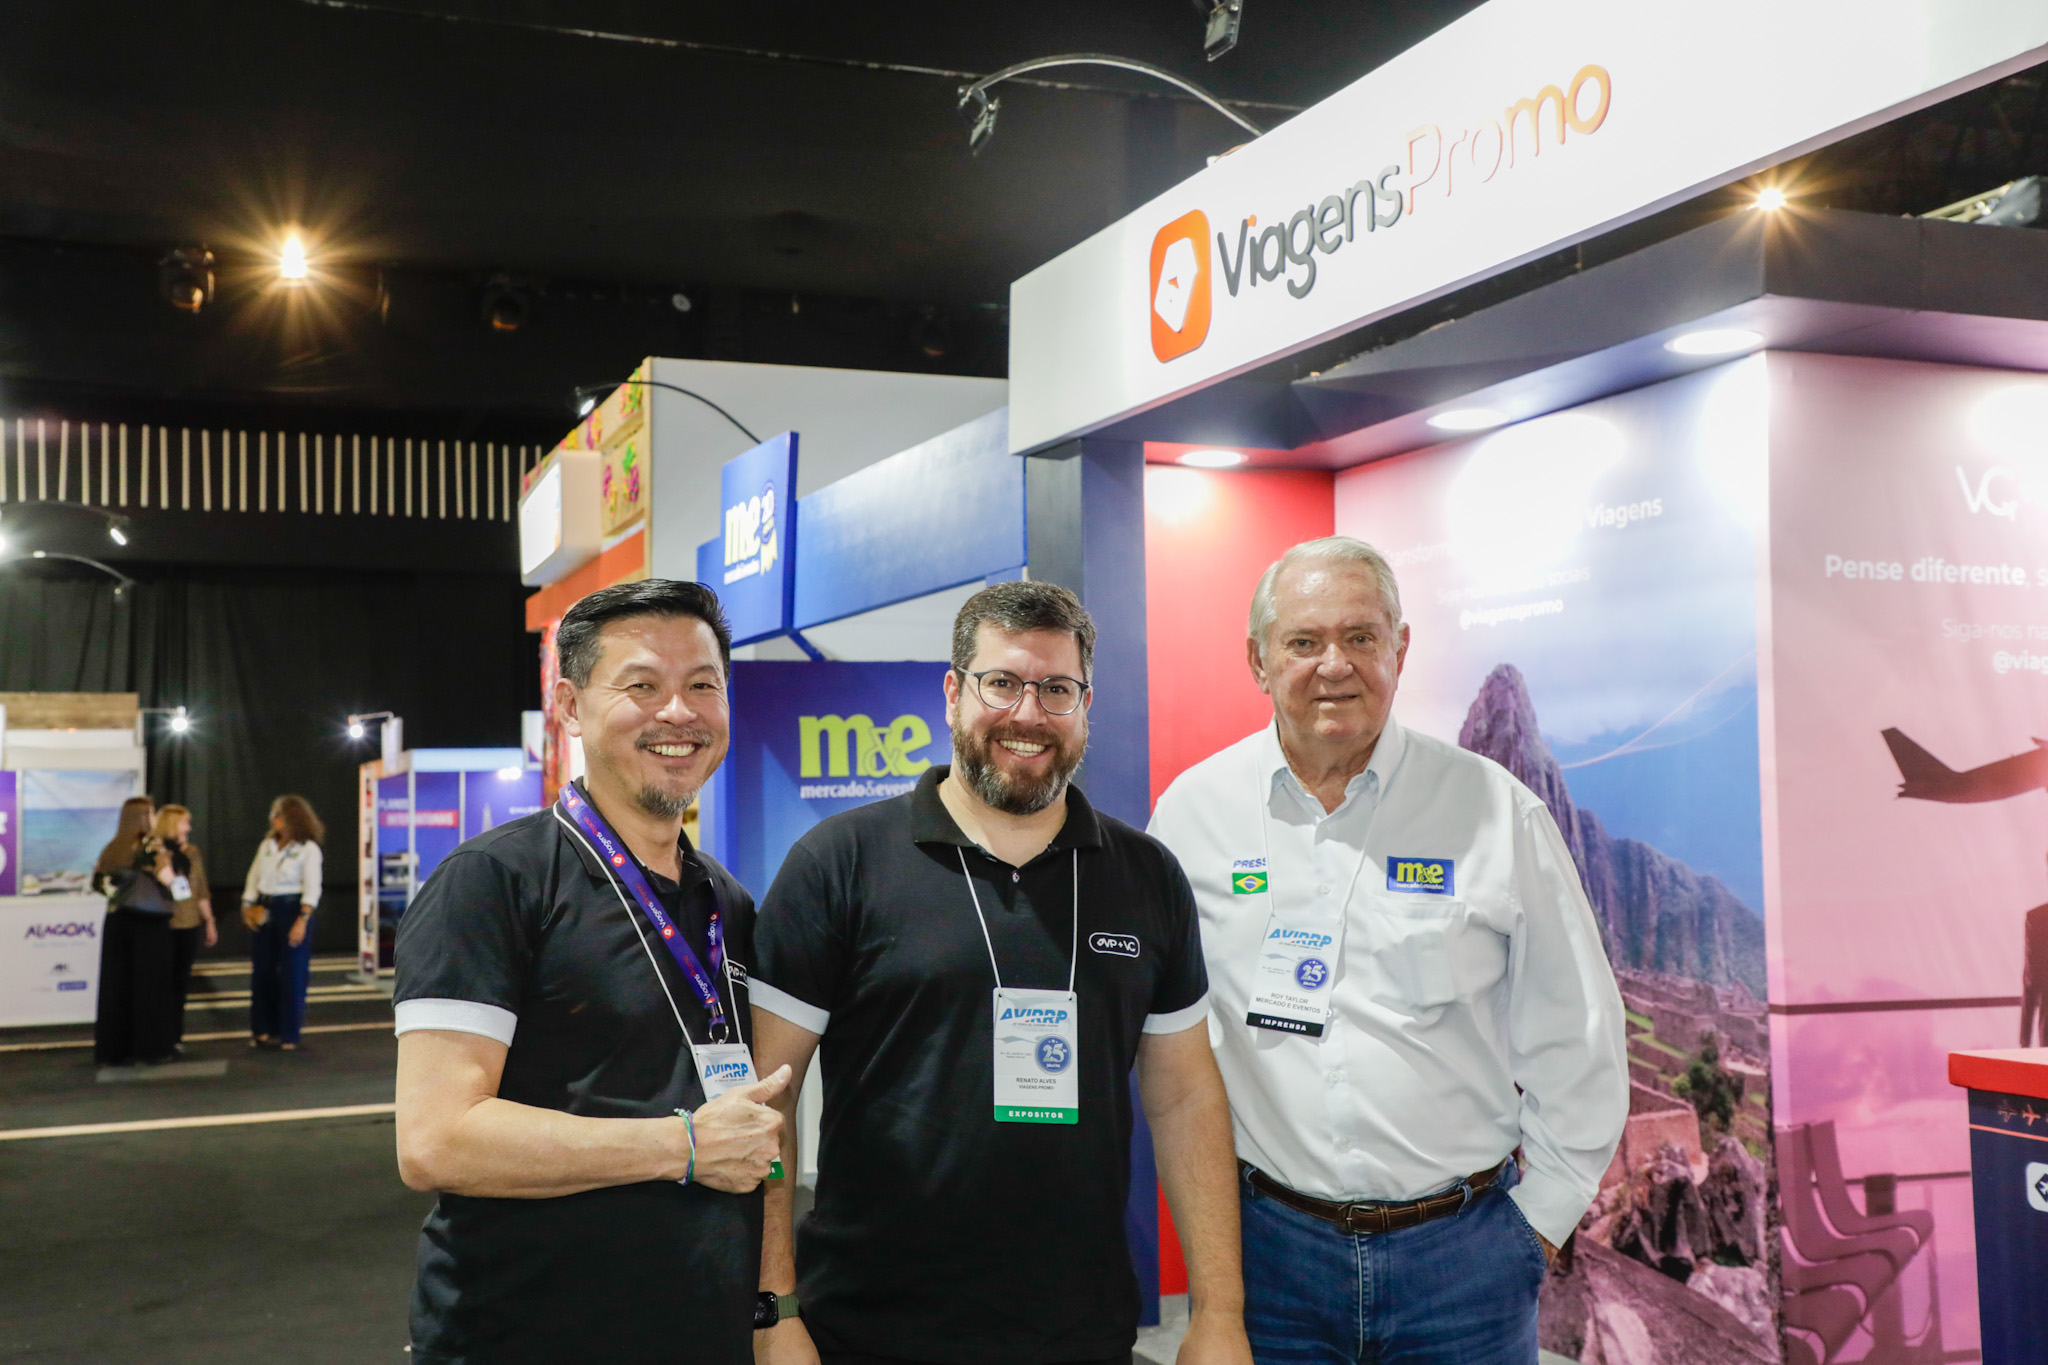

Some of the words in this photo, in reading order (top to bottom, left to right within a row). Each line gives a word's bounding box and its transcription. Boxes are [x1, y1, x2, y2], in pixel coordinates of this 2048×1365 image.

[1216, 63, 1612, 300] ViagensPromo
[1585, 497, 1664, 529] Viagens
[1824, 554, 1905, 581] Pense
[1910, 556, 2031, 588] diferente,
[1941, 617, 2024, 643] Siga-nos
[798, 714, 933, 779] m&e
[800, 780, 916, 799] mercado&event
[1396, 862, 1444, 884] m&e
[25, 921, 96, 939] ALAGOAS
[1267, 928, 1333, 948] AVIRRP
[1301, 964, 1324, 983] 25
[1256, 997, 1286, 1008] MERCADO
[1292, 1004, 1321, 1014] EVENTOS
[1285, 995, 1309, 1004] TAYLOR
[1000, 1008, 1068, 1024] AVIRRP
[1260, 1018, 1307, 1031] IMPRENSA
[1043, 1043, 1065, 1063] 25
[704, 1062, 749, 1078] AVIRRP
[1008, 1110, 1064, 1119] EXPOSITOR
